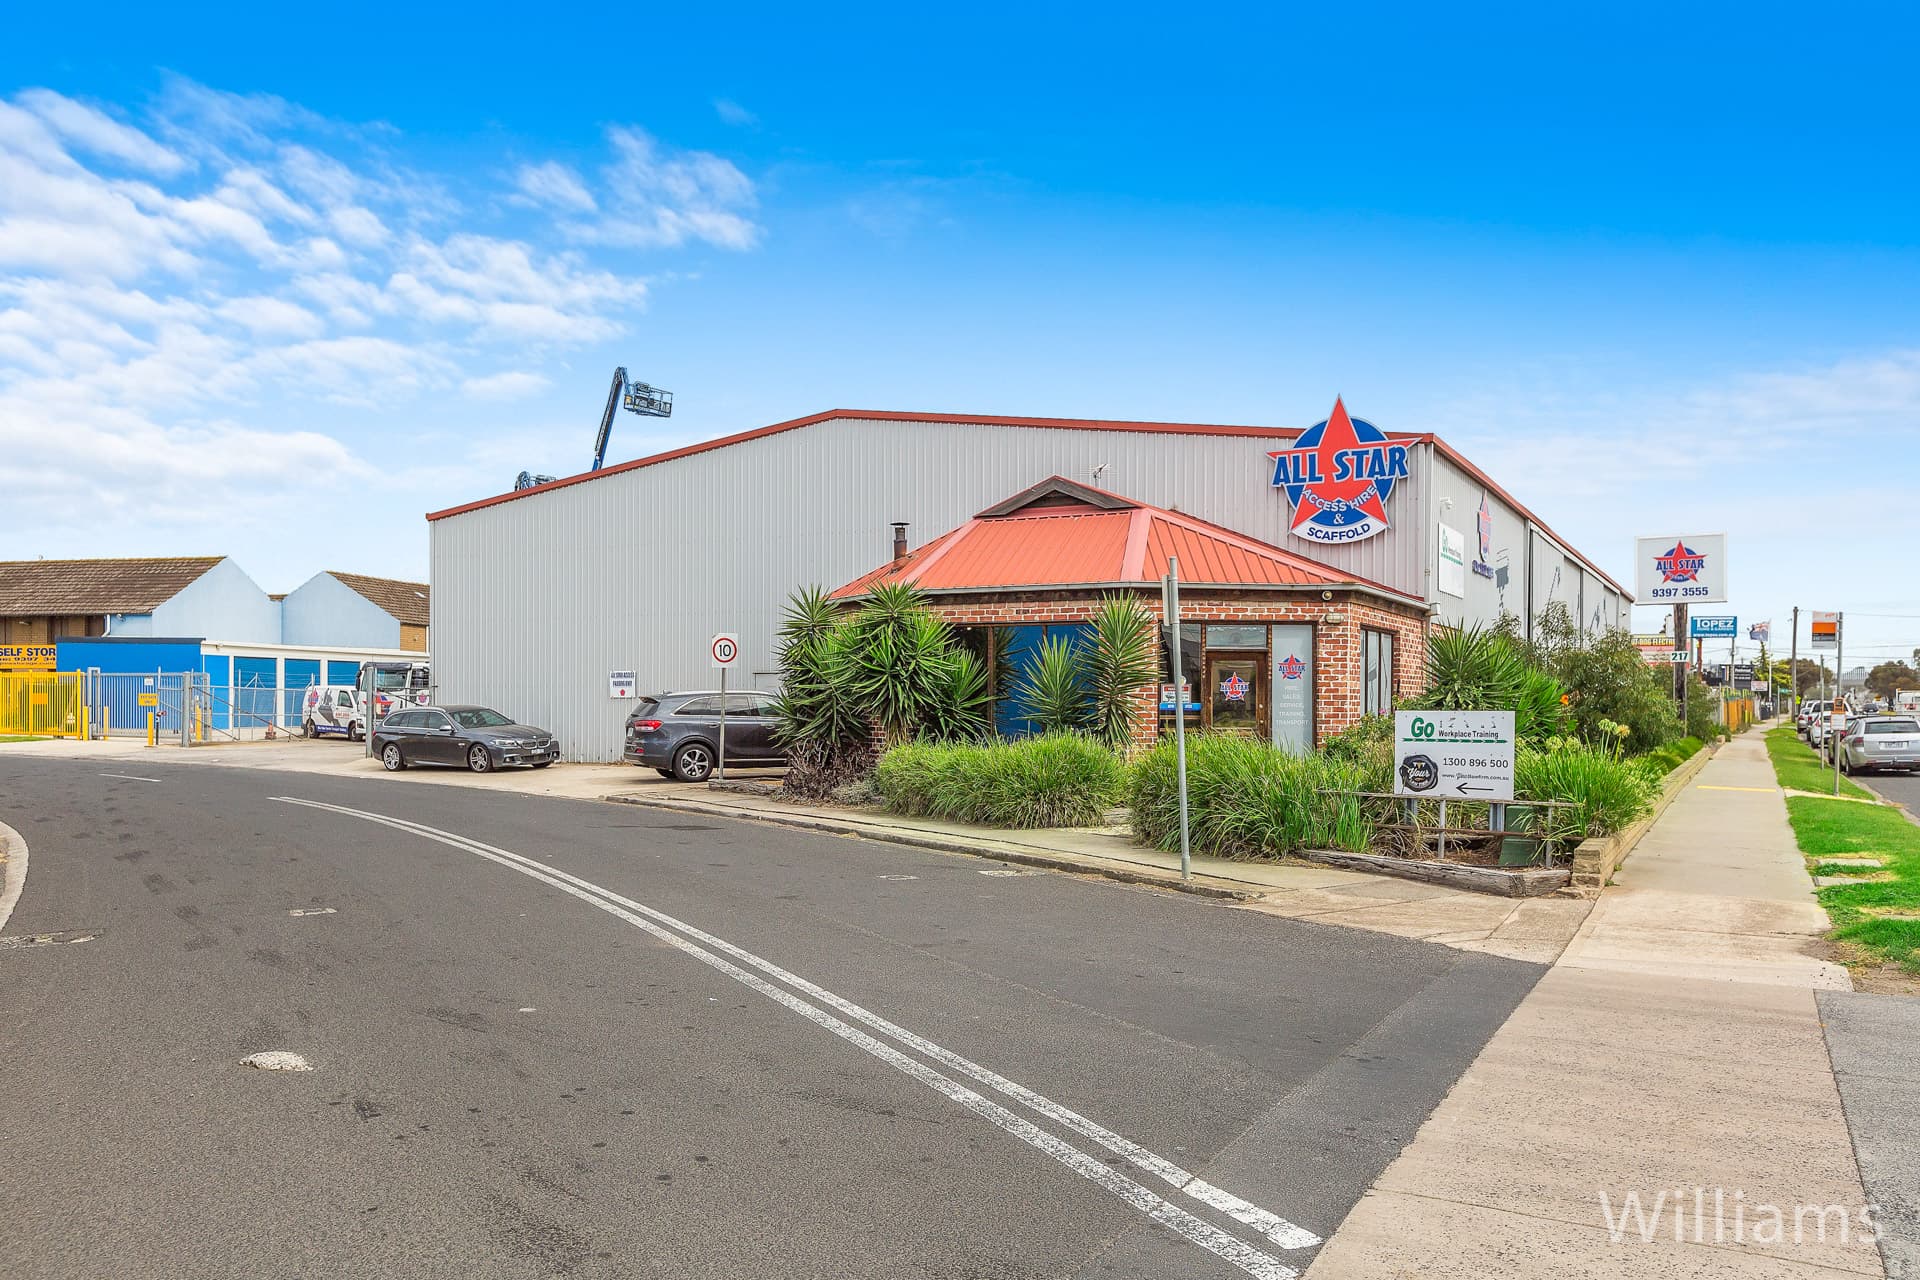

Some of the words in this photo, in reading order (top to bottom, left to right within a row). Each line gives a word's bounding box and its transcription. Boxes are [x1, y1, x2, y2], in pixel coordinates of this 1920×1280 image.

[1272, 453, 1324, 487] ALL
[1333, 446, 1408, 482] STAR
[1303, 488, 1347, 512] ACCESS
[1349, 485, 1377, 510] HIRE
[1333, 513, 1344, 525] &
[1307, 523, 1371, 541] SCAFFOLD
[1656, 560, 1675, 571] ALL
[1679, 559, 1705, 570] STAR
[1652, 588, 1678, 598] 9397
[1682, 587, 1709, 597] 3555
[718, 644, 732, 657] 10
[1671, 653, 1689, 661] 217
[1411, 717, 1435, 738] Go
[1438, 730, 1472, 739] Workplace
[1472, 731, 1499, 740] Training
[1443, 758, 1466, 767] 1300
[1469, 759, 1487, 768] 896
[1490, 759, 1509, 768] 500
